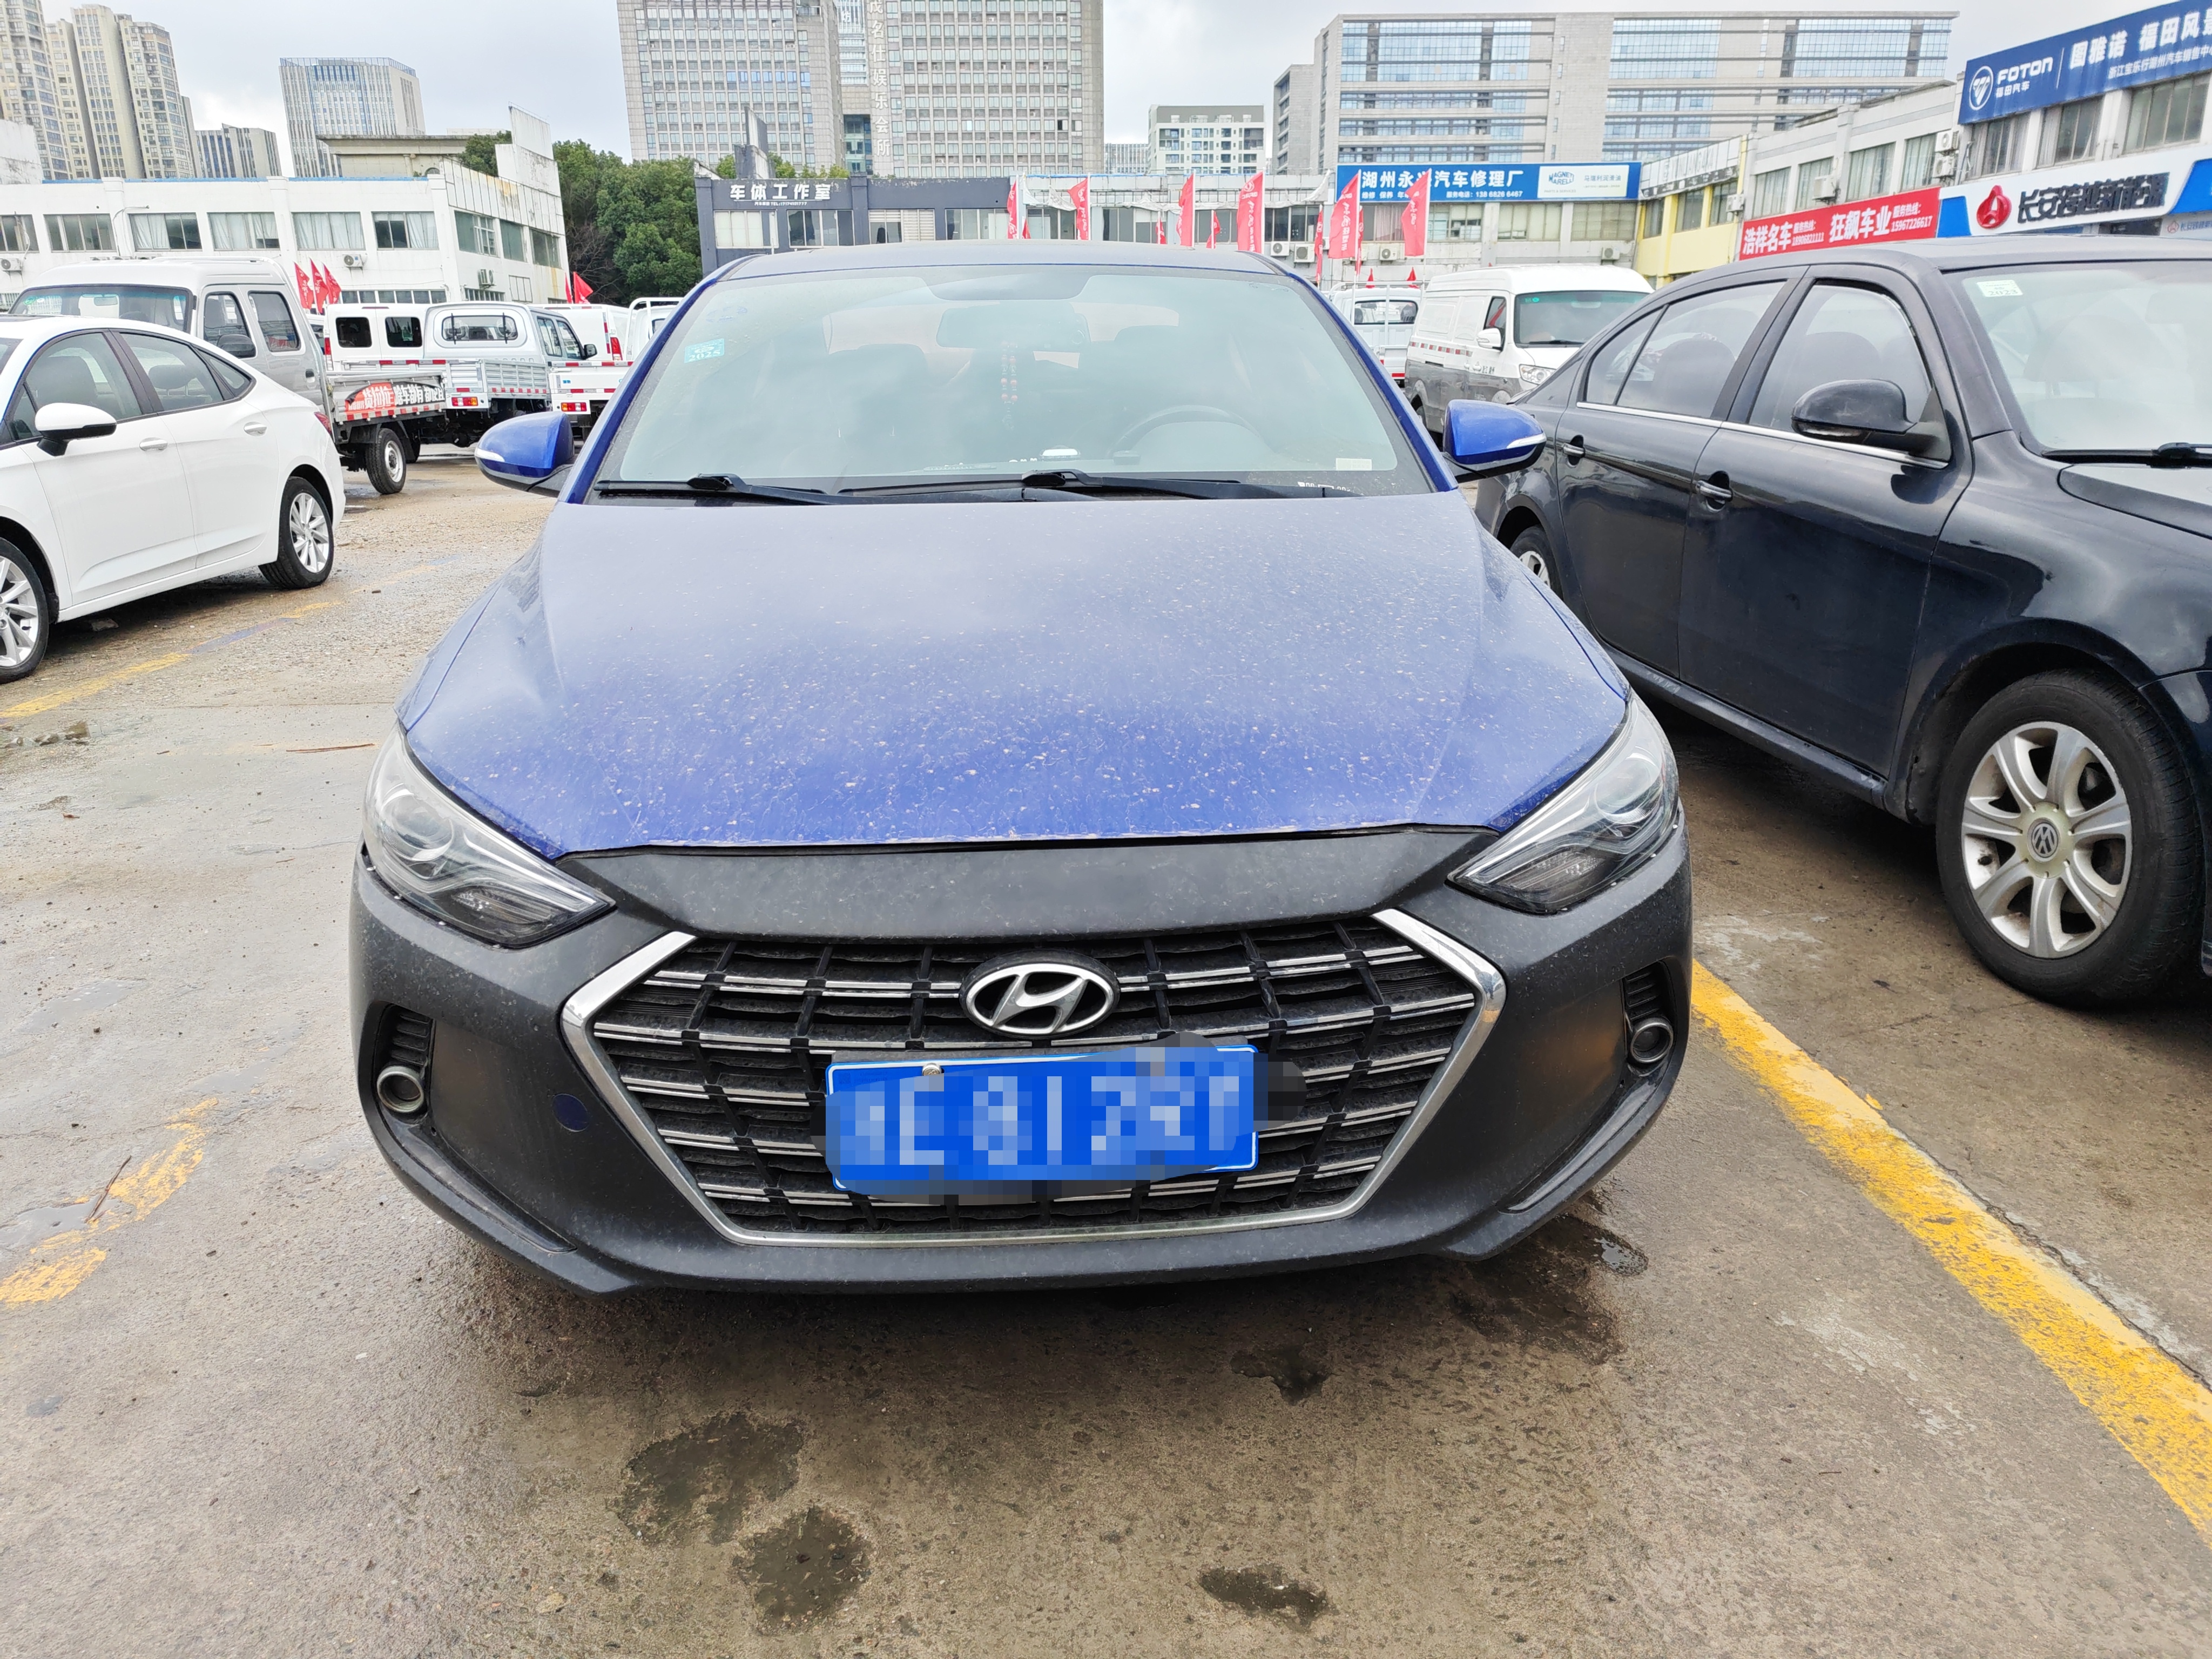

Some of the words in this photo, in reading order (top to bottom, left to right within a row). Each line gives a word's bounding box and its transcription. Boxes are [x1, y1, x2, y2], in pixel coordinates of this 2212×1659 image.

[2069, 30, 2128, 70] 图雅诺
[1998, 57, 2053, 85] FOTON
[1996, 80, 2030, 98] 福田汽车
[730, 184, 831, 200] 车体工作室
[1890, 215, 1933, 233] 15967226617
[1742, 221, 1793, 255] 浩祥名车
[688, 349, 721, 362] 2025
